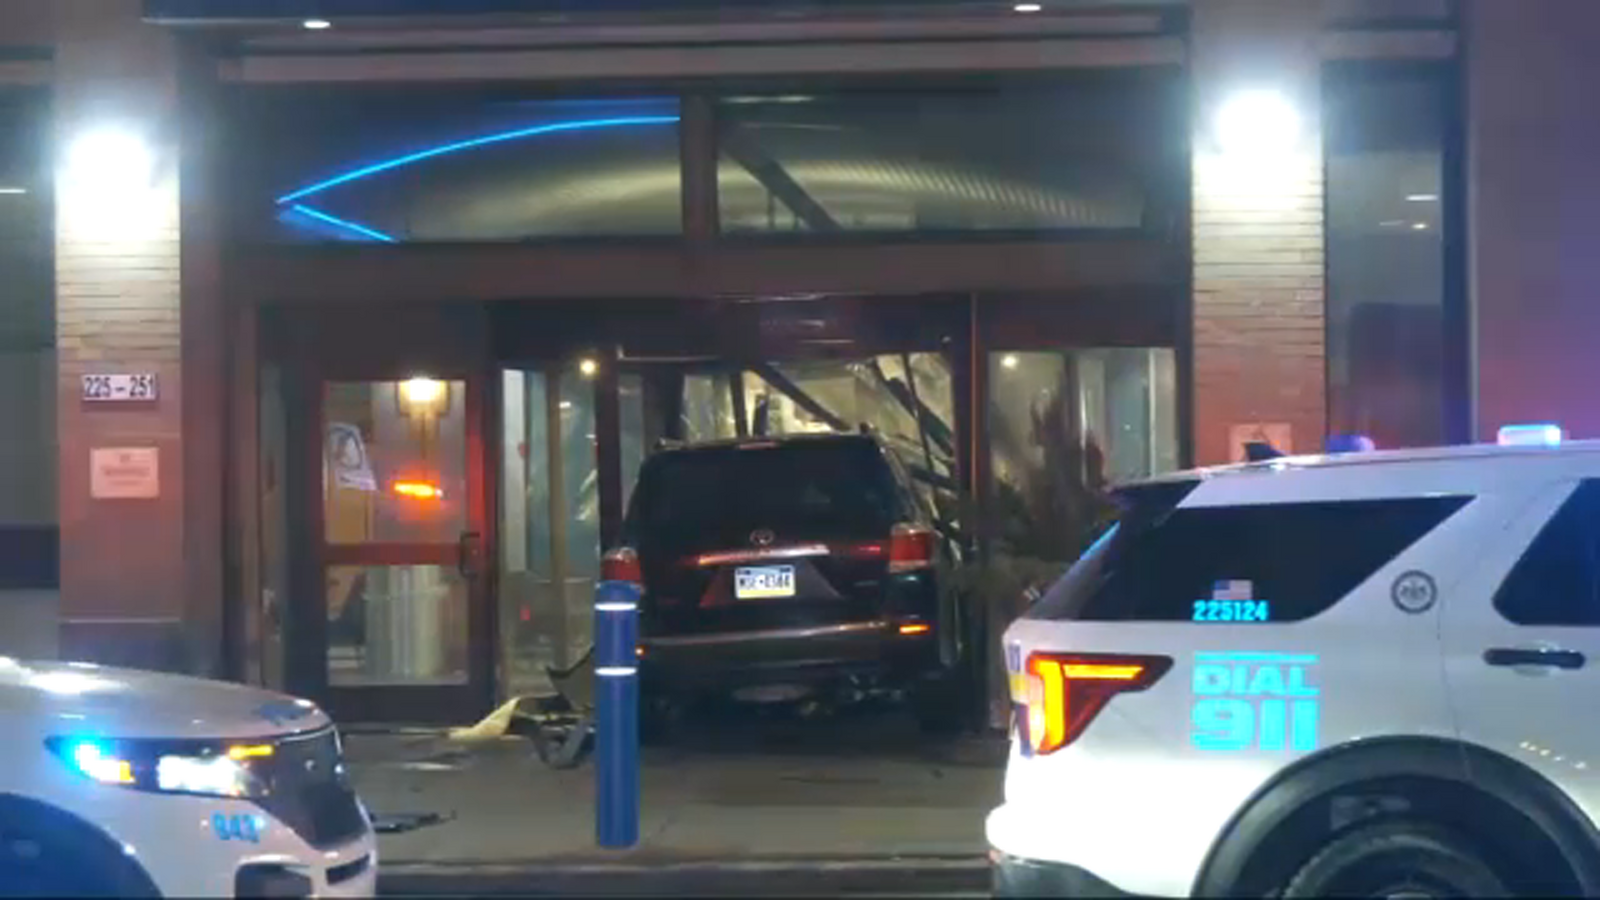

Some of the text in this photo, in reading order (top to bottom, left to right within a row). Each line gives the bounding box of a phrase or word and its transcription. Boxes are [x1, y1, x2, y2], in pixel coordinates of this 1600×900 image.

[85, 376, 111, 398] 225
[129, 375, 155, 397] 251
[1193, 600, 1268, 621] 225124
[1193, 665, 1320, 695] DIAL
[1192, 699, 1318, 750] 911
